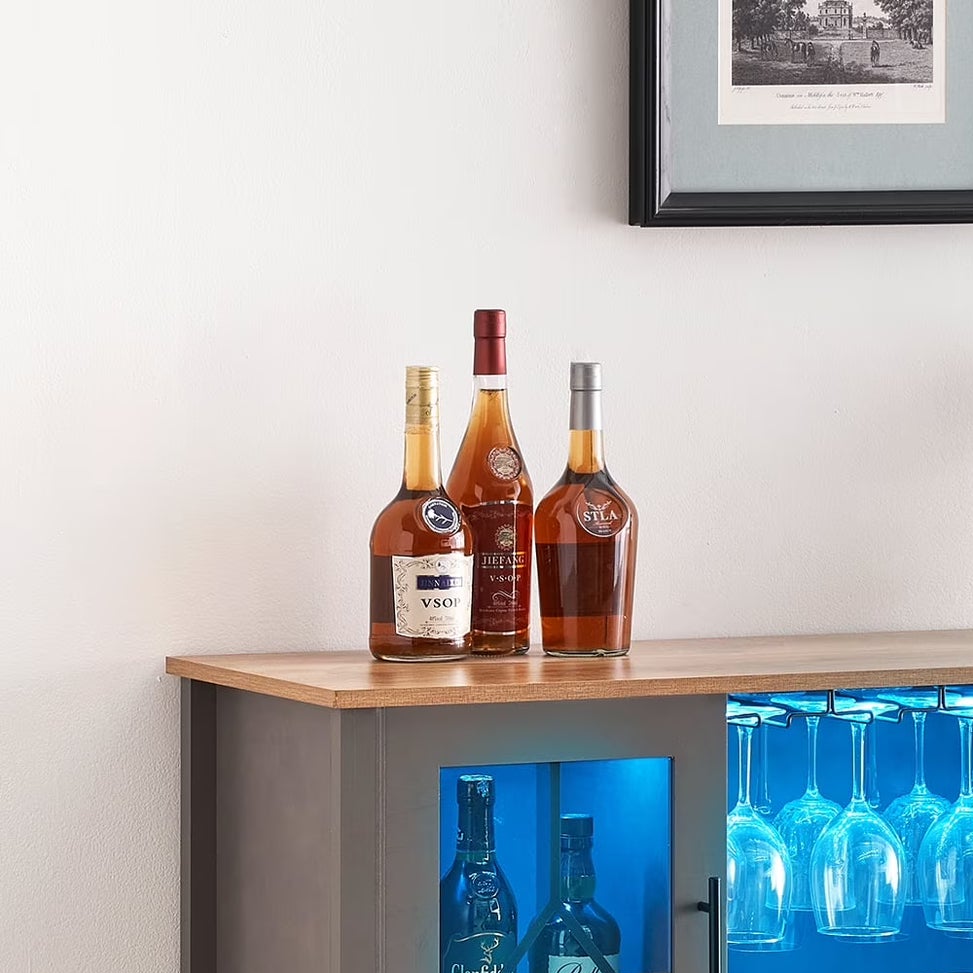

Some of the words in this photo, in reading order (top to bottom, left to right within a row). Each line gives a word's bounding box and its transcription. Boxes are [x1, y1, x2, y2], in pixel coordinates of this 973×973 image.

[583, 510, 618, 521] STLA
[482, 556, 524, 565] JIEFANG
[420, 597, 461, 609] VSOP
